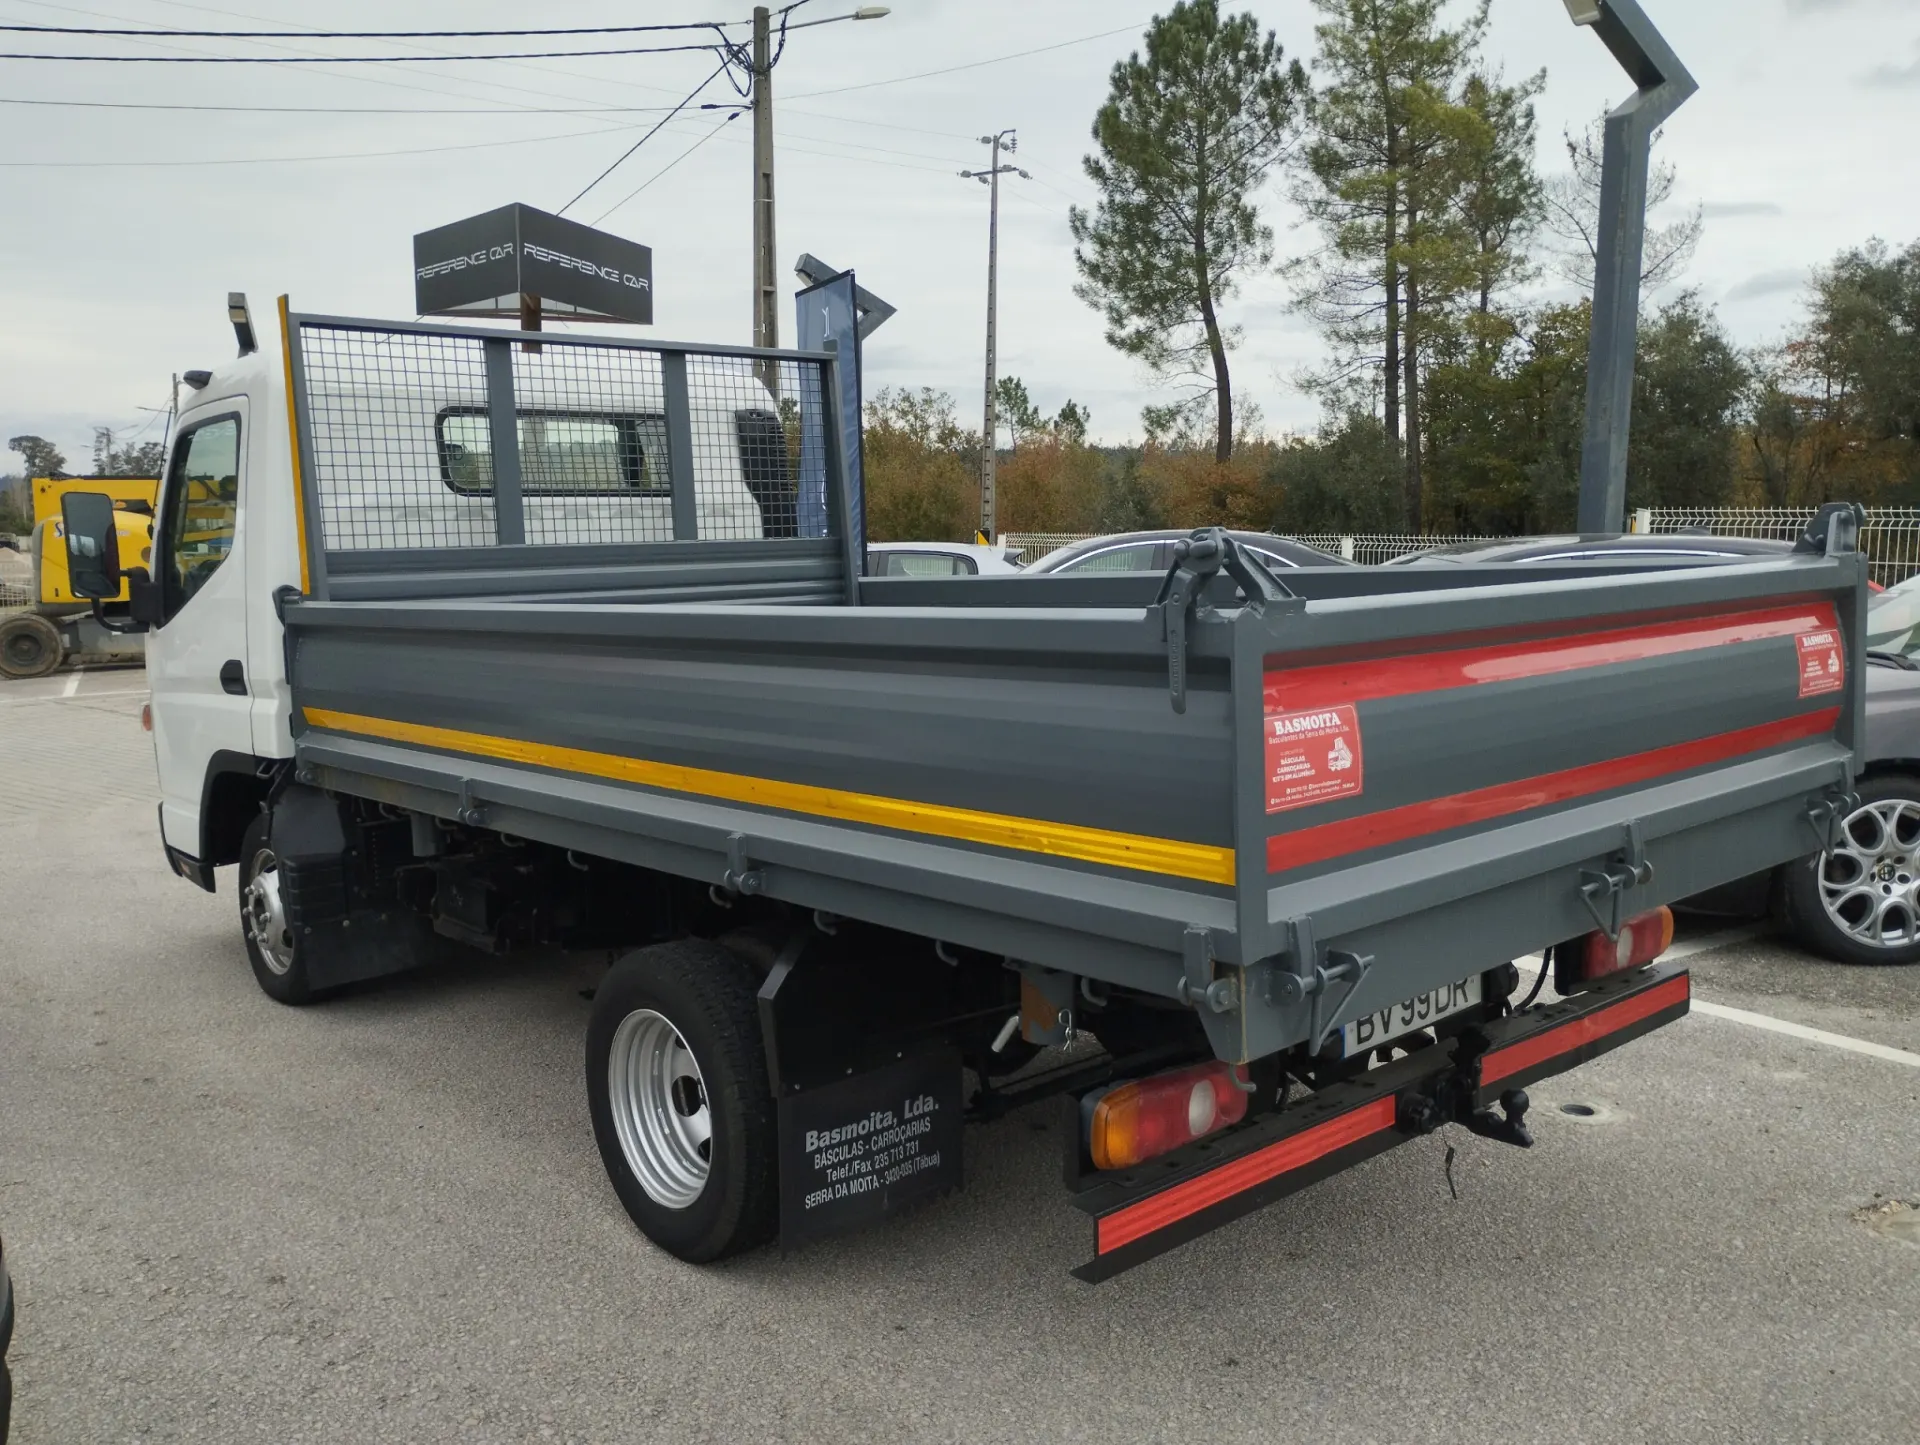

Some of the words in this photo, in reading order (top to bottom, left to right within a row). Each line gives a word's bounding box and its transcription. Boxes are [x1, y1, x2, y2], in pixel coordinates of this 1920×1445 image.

[416, 249, 487, 280] REFERENCE
[489, 242, 514, 261] CAR
[523, 242, 620, 283] REFERENCE
[623, 273, 650, 292] CAR
[1274, 712, 1341, 735] BASMOITA
[805, 1110, 898, 1153] Basmoita,
[904, 1094, 939, 1119] Lda.
[814, 1140, 864, 1169] BÁSCULAS
[871, 1117, 931, 1151] CARROÇARIAS
[826, 1160, 872, 1182] Telef./Fax
[874, 1151, 889, 1170] 235
[891, 1145, 904, 1163] 713
[906, 1140, 919, 1157] 731
[805, 1187, 834, 1209] SERRA
[835, 1184, 849, 1199] DA
[850, 1174, 880, 1194] MOITA
